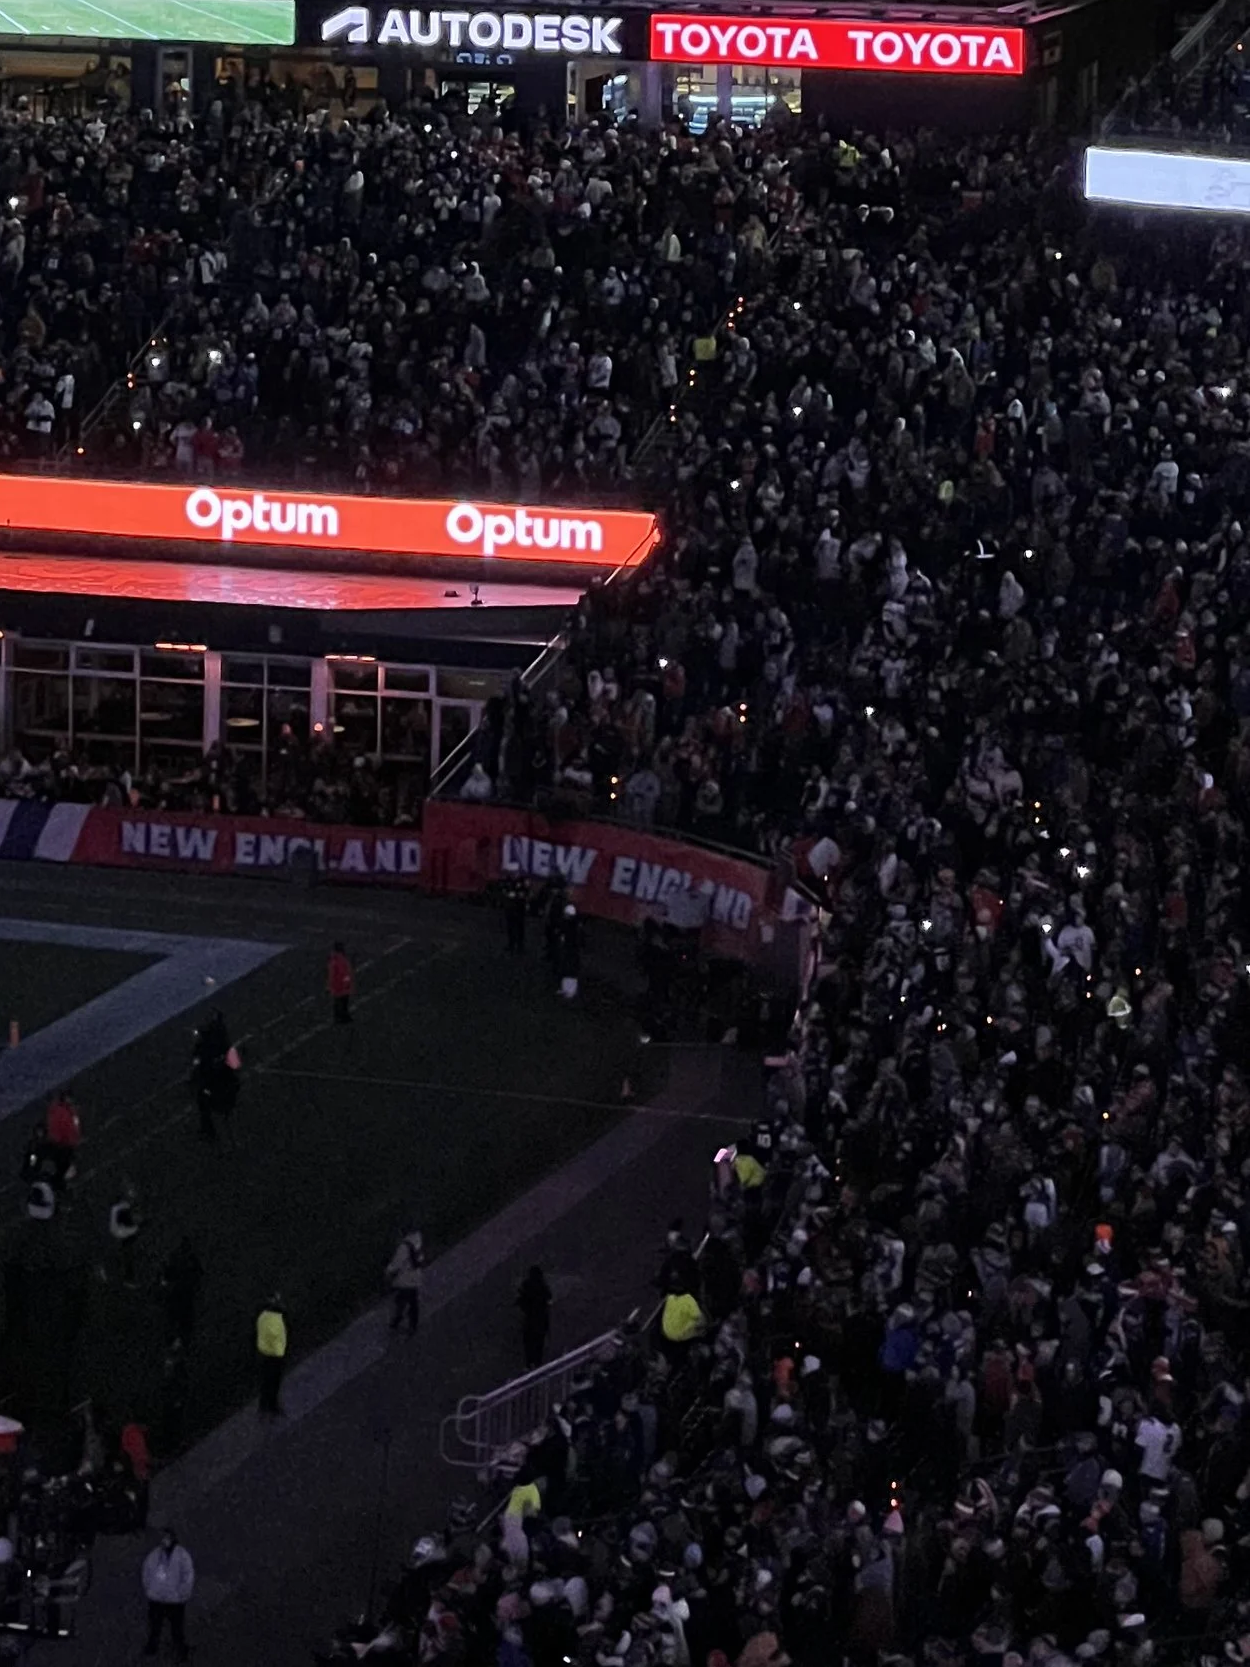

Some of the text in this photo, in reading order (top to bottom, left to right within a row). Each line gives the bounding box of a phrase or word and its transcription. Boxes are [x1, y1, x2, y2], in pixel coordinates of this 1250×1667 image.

[378, 9, 623, 55] AUTODESK
[657, 21, 1013, 68] TOYOTA TOYOTA
[186, 488, 338, 541] Optum
[446, 503, 602, 556] Optum
[121, 821, 218, 861] NEW
[609, 855, 752, 930] ENGND
